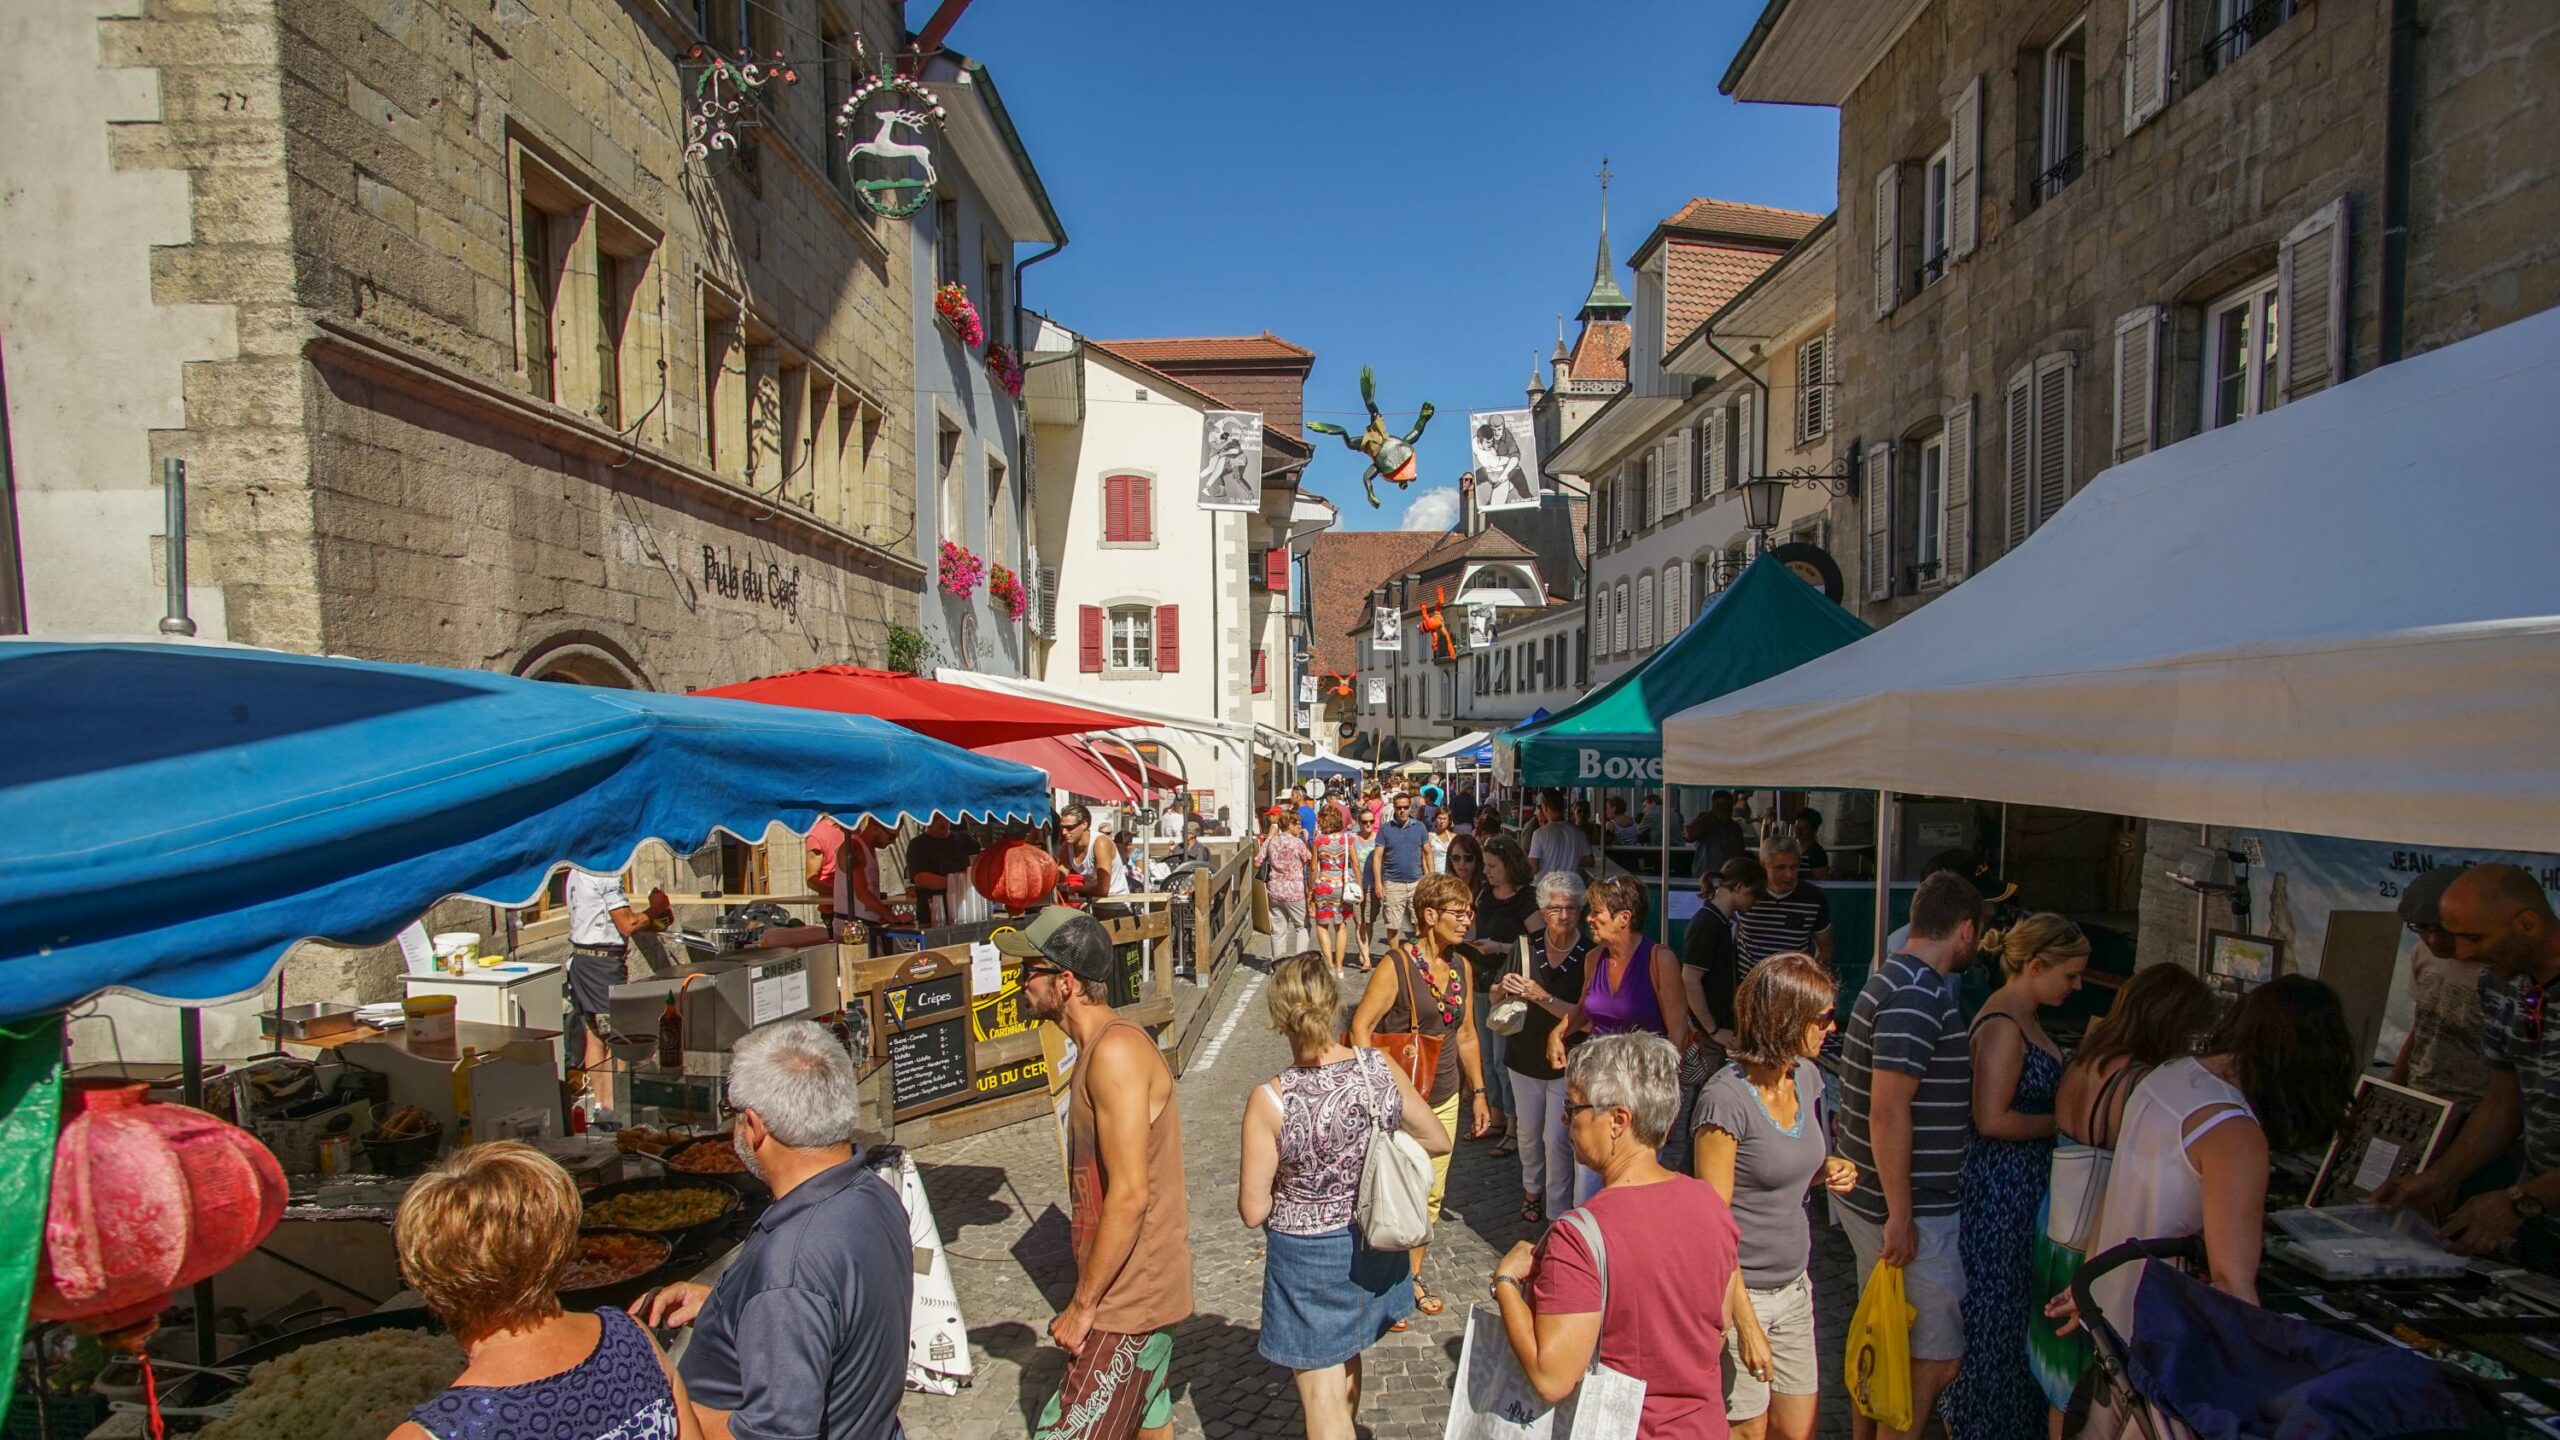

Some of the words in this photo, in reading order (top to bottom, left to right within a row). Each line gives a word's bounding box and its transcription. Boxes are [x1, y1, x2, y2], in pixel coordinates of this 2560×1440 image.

[703, 545, 739, 600] Pub
[742, 551, 765, 603] du
[767, 563, 800, 624] Cerf
[2389, 851, 2433, 874] JEAN
[2379, 880, 2398, 898] 25
[989, 1019, 1027, 1039] CARDINAL
[977, 1075, 998, 1092] UB
[1000, 1068, 1018, 1085] DU
